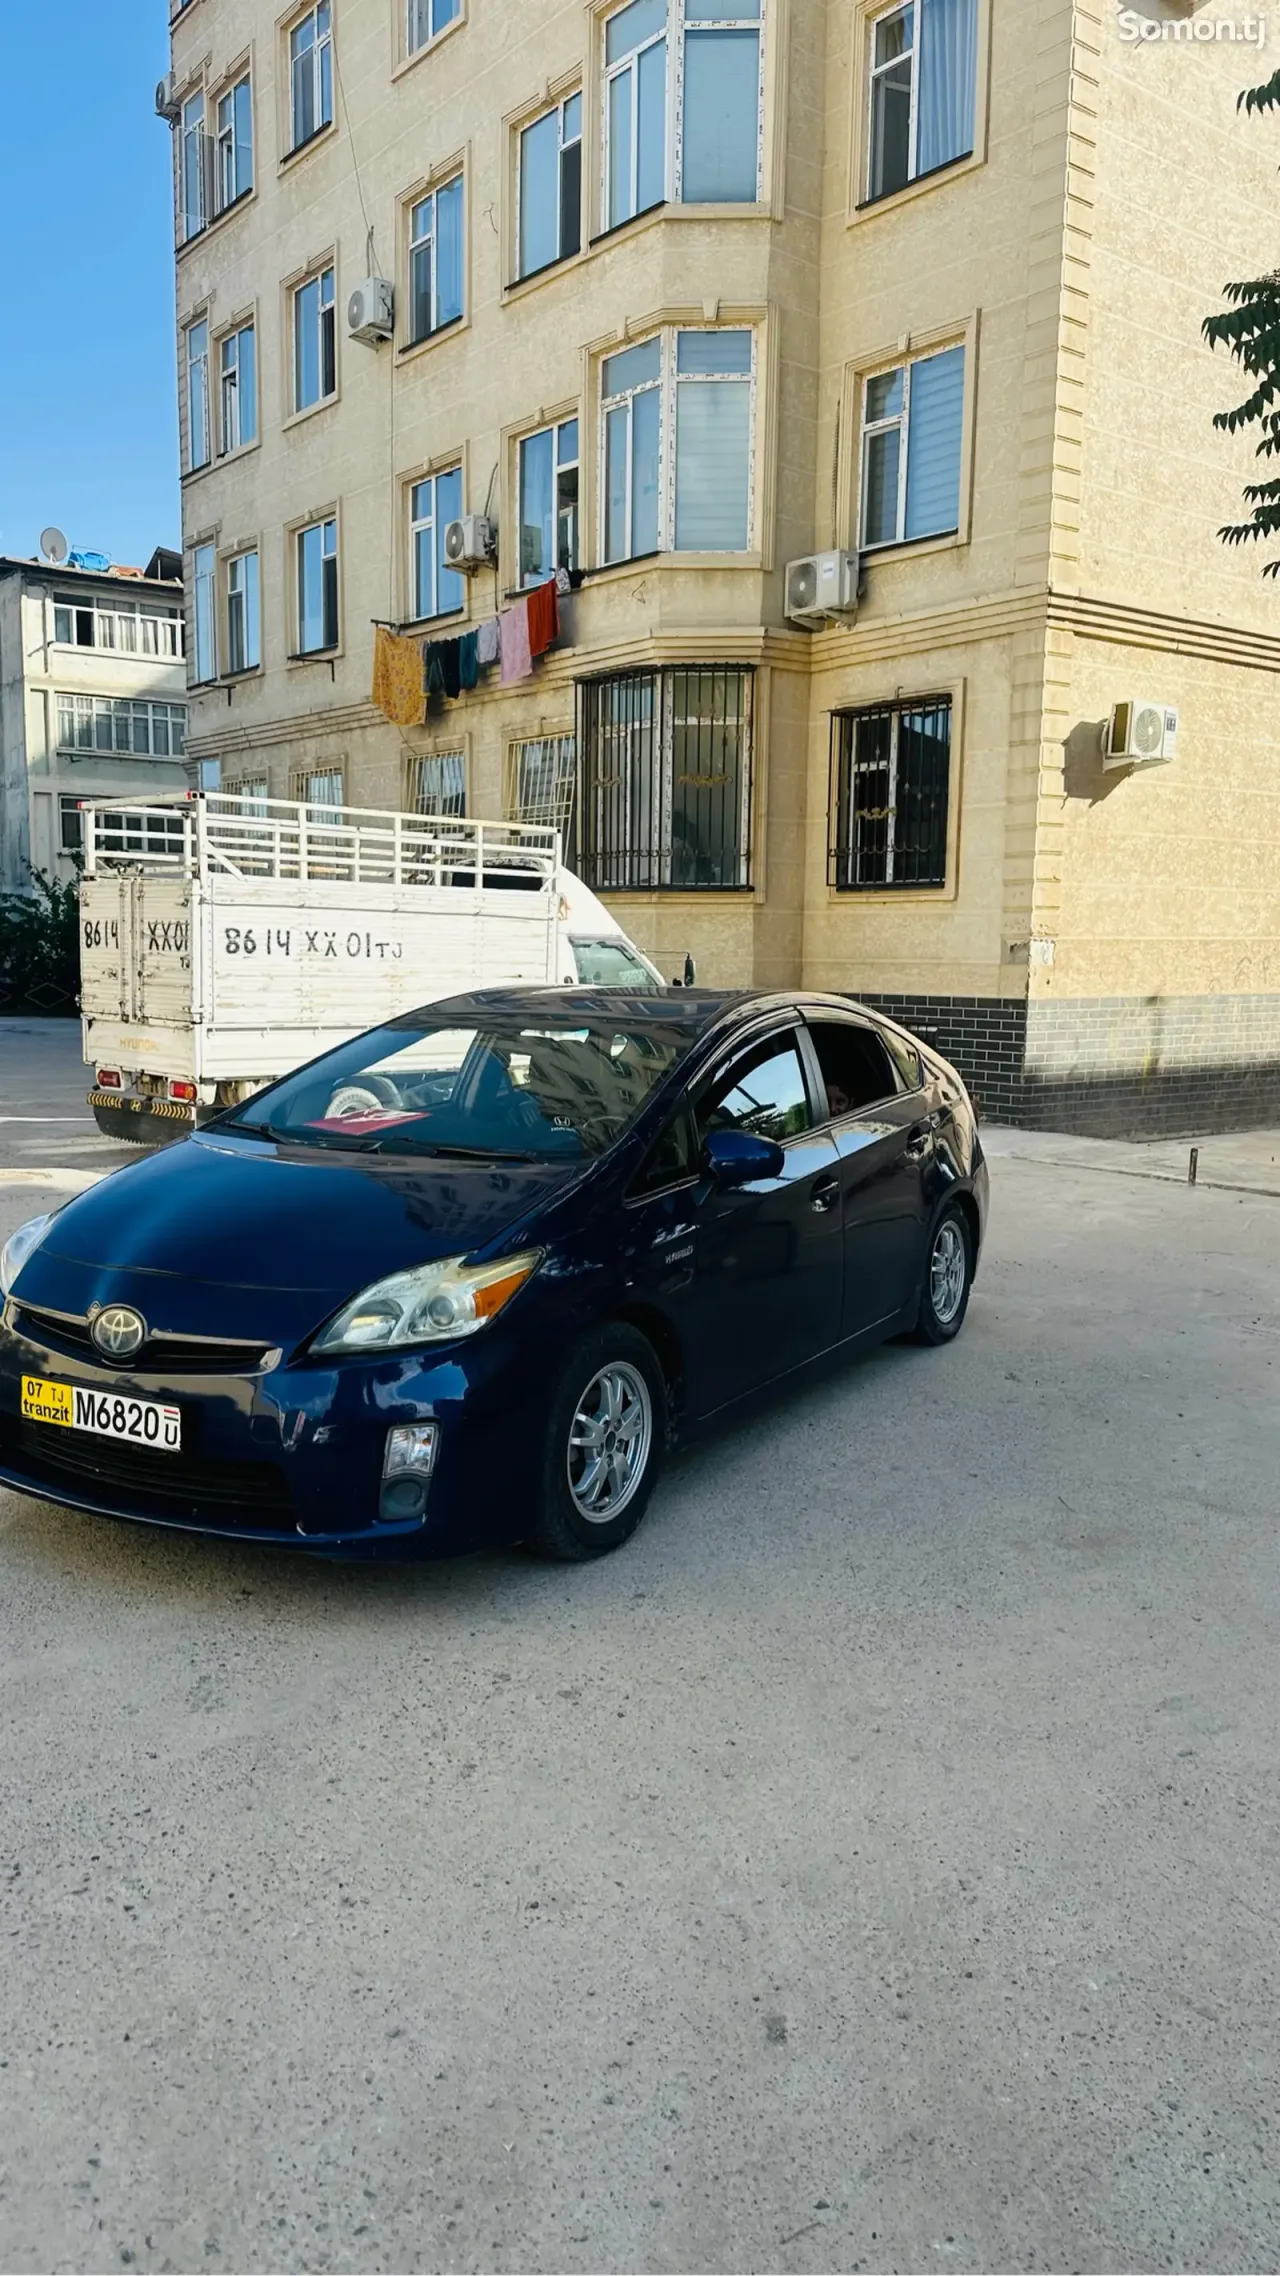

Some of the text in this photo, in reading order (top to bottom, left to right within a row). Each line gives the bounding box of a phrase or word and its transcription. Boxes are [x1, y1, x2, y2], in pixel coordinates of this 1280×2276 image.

[84, 920, 119, 949] 8614
[225, 928, 290, 956] 8614
[27, 1380, 64, 1403] 07 TJ
[23, 1398, 70, 1423] tranzit
[76, 1391, 159, 1441] M6820
[164, 1423, 178, 1446] U
